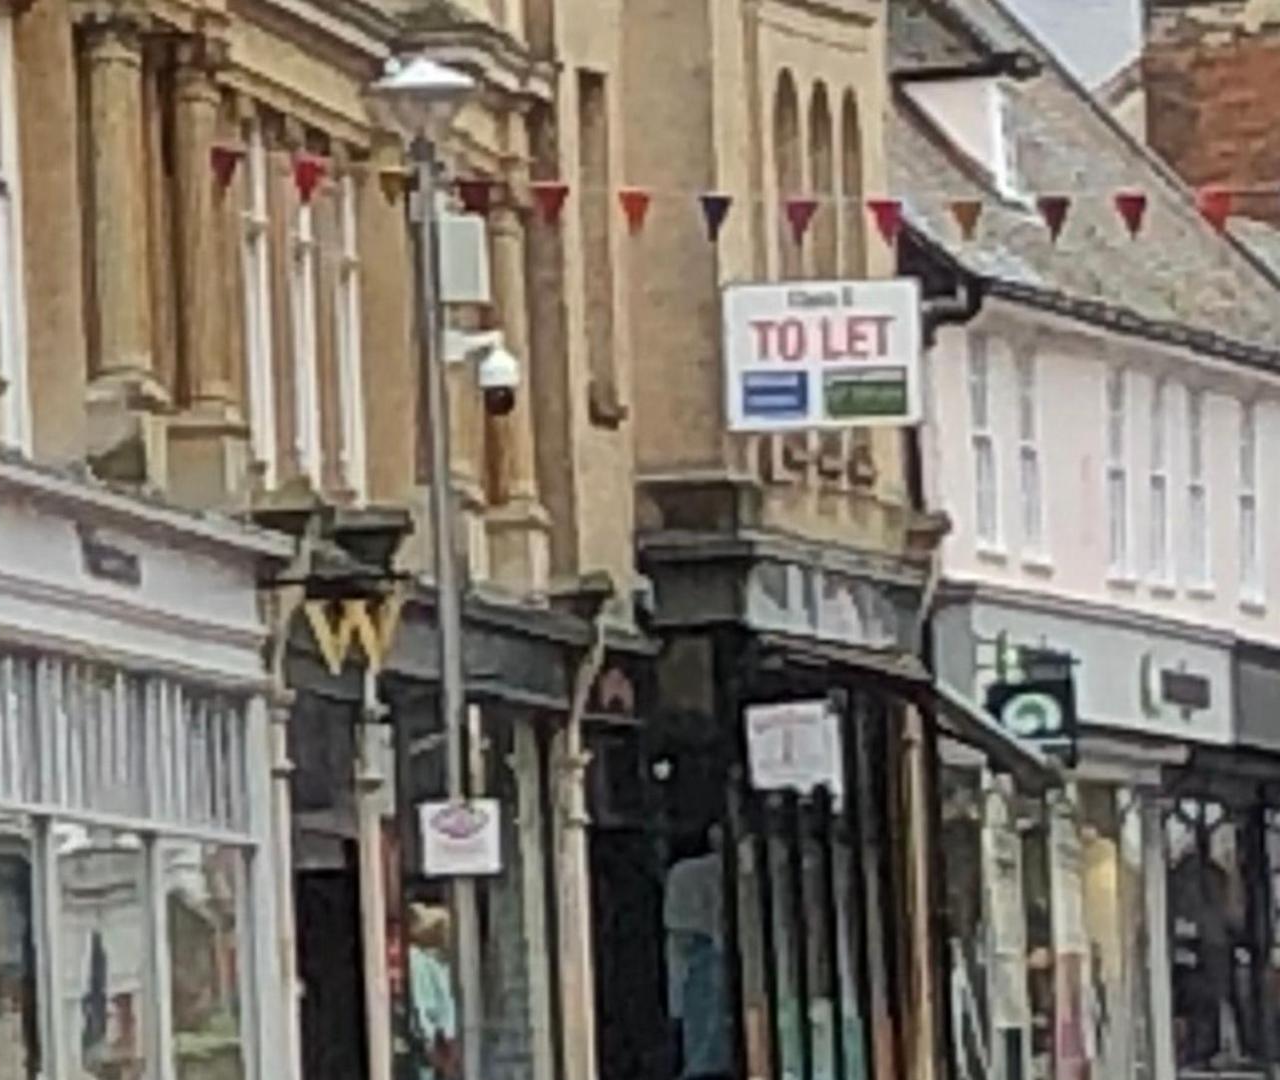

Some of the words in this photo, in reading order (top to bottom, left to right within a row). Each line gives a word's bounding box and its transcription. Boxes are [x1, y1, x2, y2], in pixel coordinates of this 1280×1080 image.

[748, 316, 807, 362] TO
[819, 314, 898, 361] LET
[304, 588, 401, 676] W
